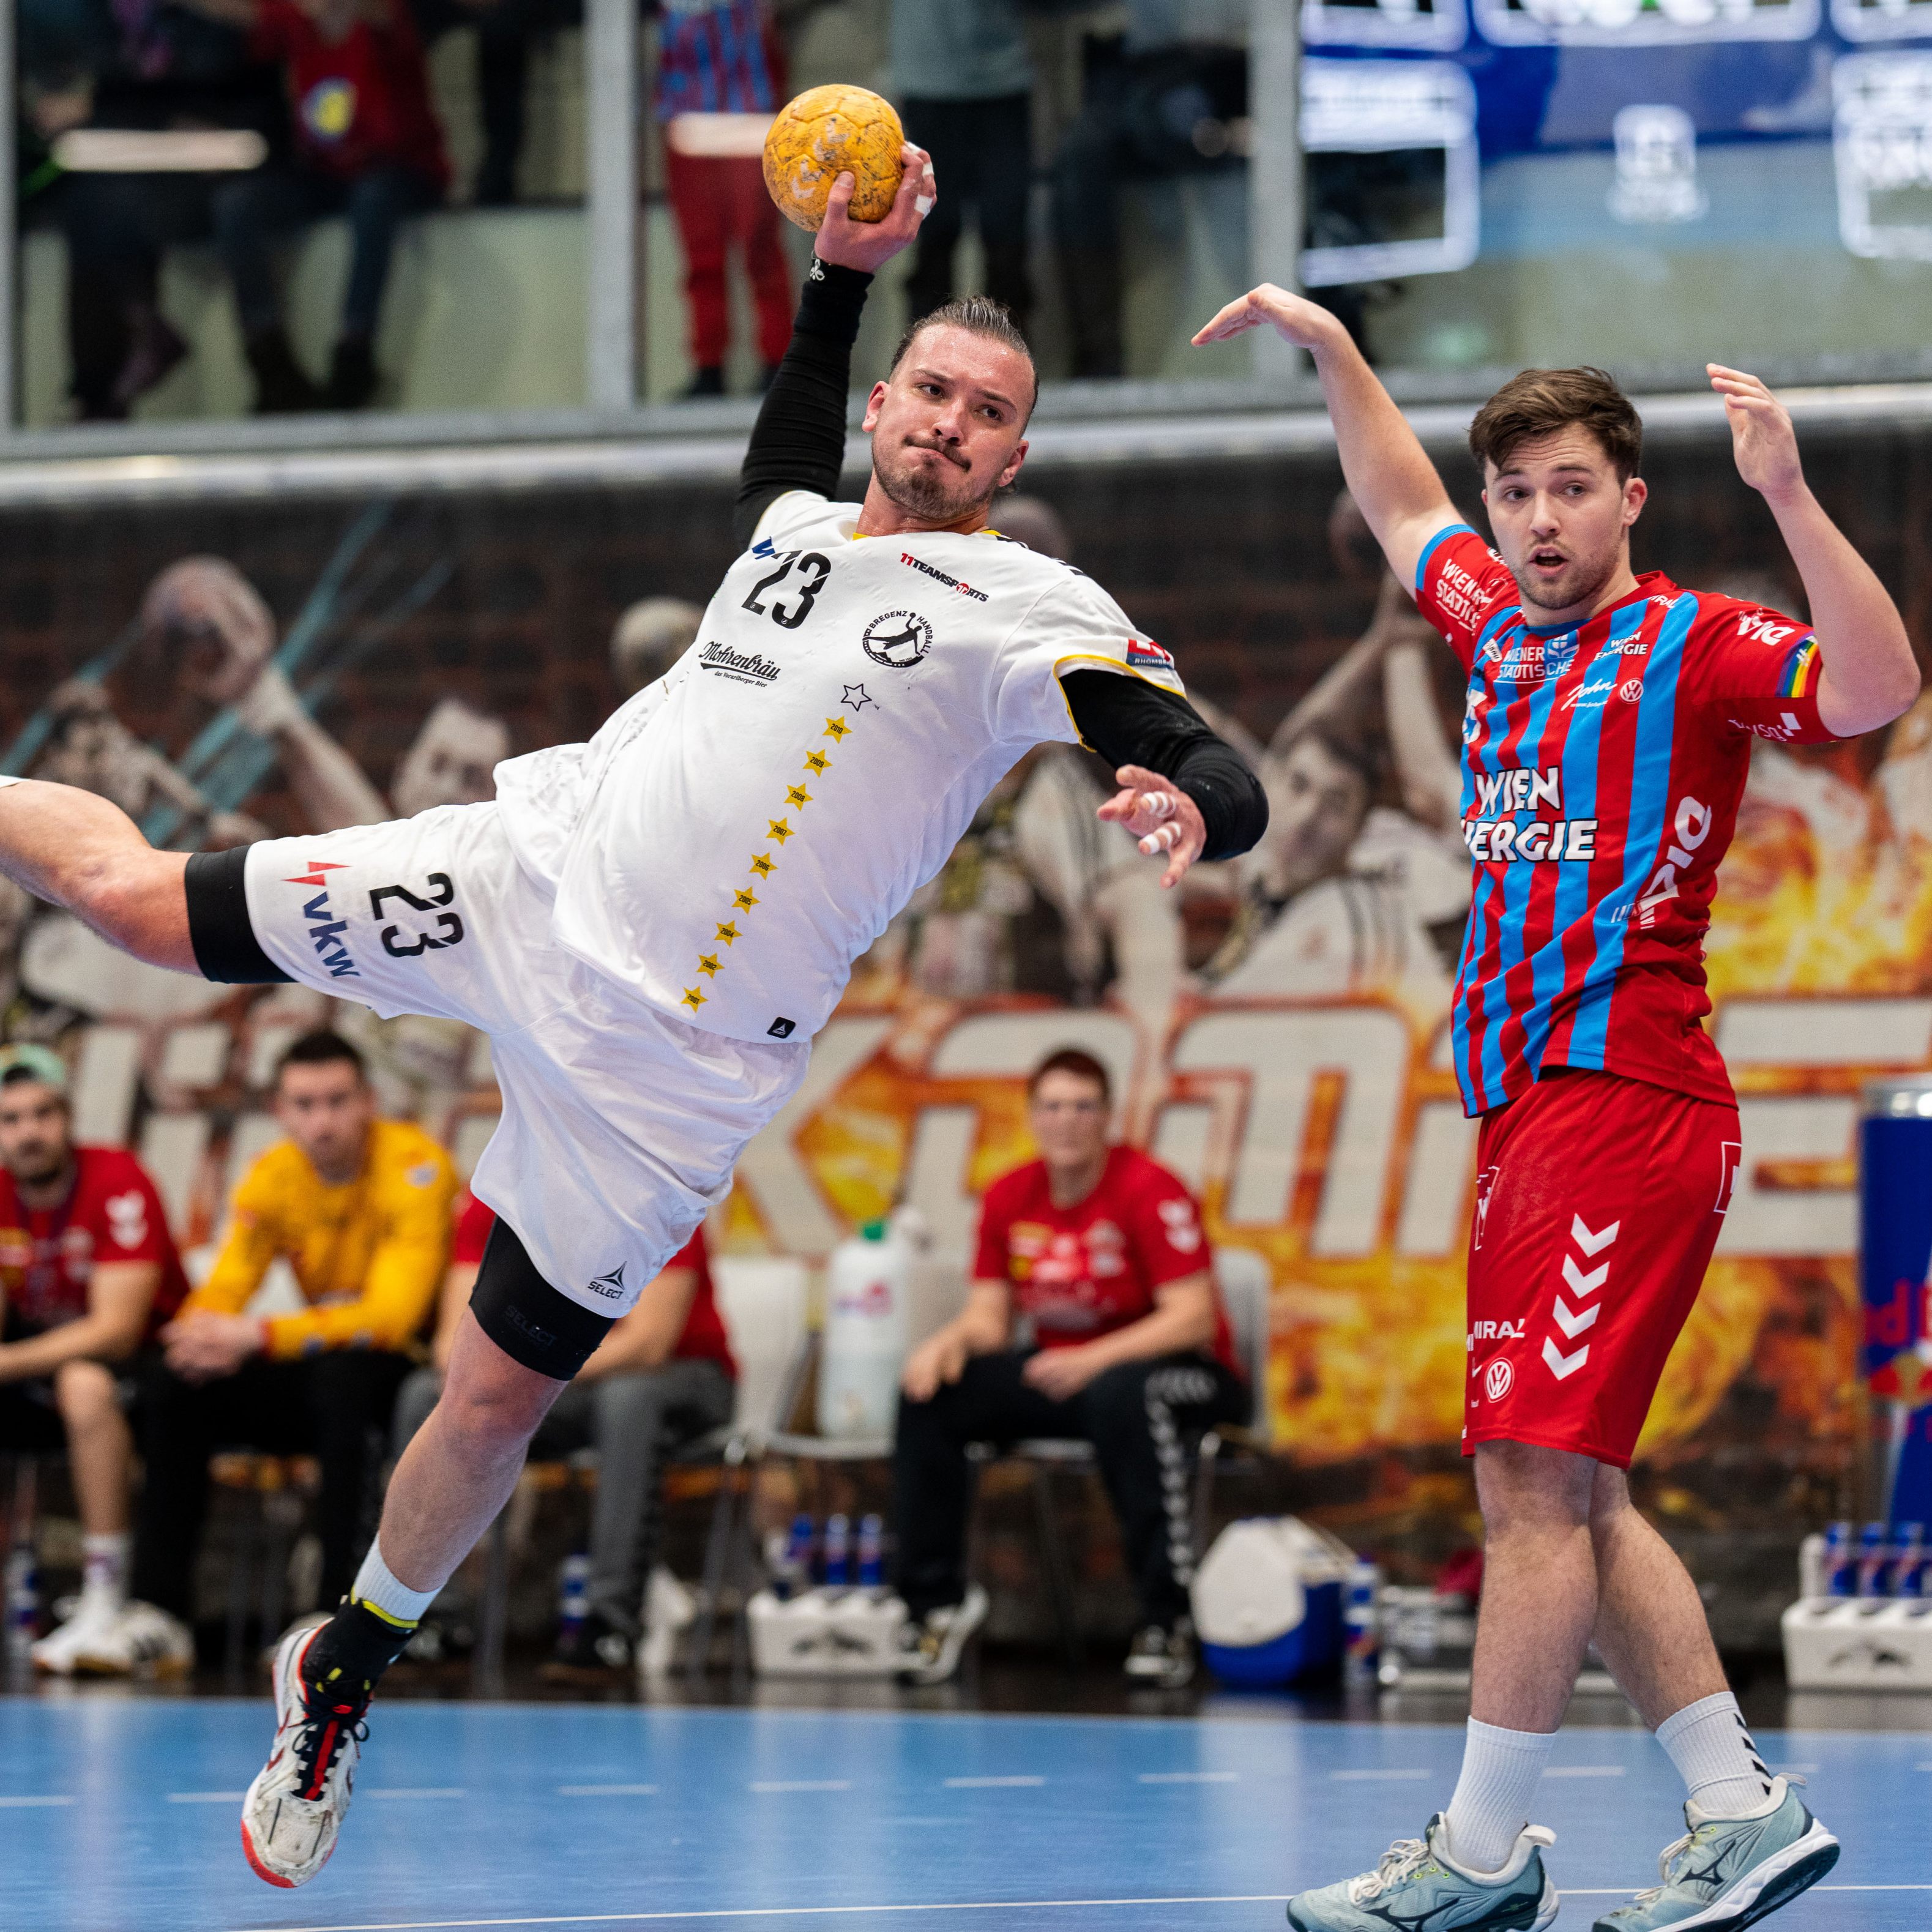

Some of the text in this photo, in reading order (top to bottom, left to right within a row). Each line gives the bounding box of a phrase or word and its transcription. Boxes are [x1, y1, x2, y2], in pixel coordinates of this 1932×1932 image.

[741, 550, 832, 629] 23
[868, 610, 908, 629] BREGENZ
[916, 616, 933, 654] HANDBALL
[698, 641, 781, 679] Mohrenbräu
[830, 723, 844, 734] 2010
[810, 756, 824, 768] 2009
[791, 790, 805, 802] 2008
[1475, 765, 1561, 816] WIEN
[773, 825, 788, 837] 2007
[1460, 817, 1599, 863] NERGIE
[755, 859, 770, 871] 2006
[738, 894, 753, 906] 2005
[368, 872, 464, 958] 23
[302, 890, 361, 977] vkw
[720, 927, 735, 938] 2004
[703, 960, 717, 971] 2002
[587, 1280, 625, 1300] SELECT
